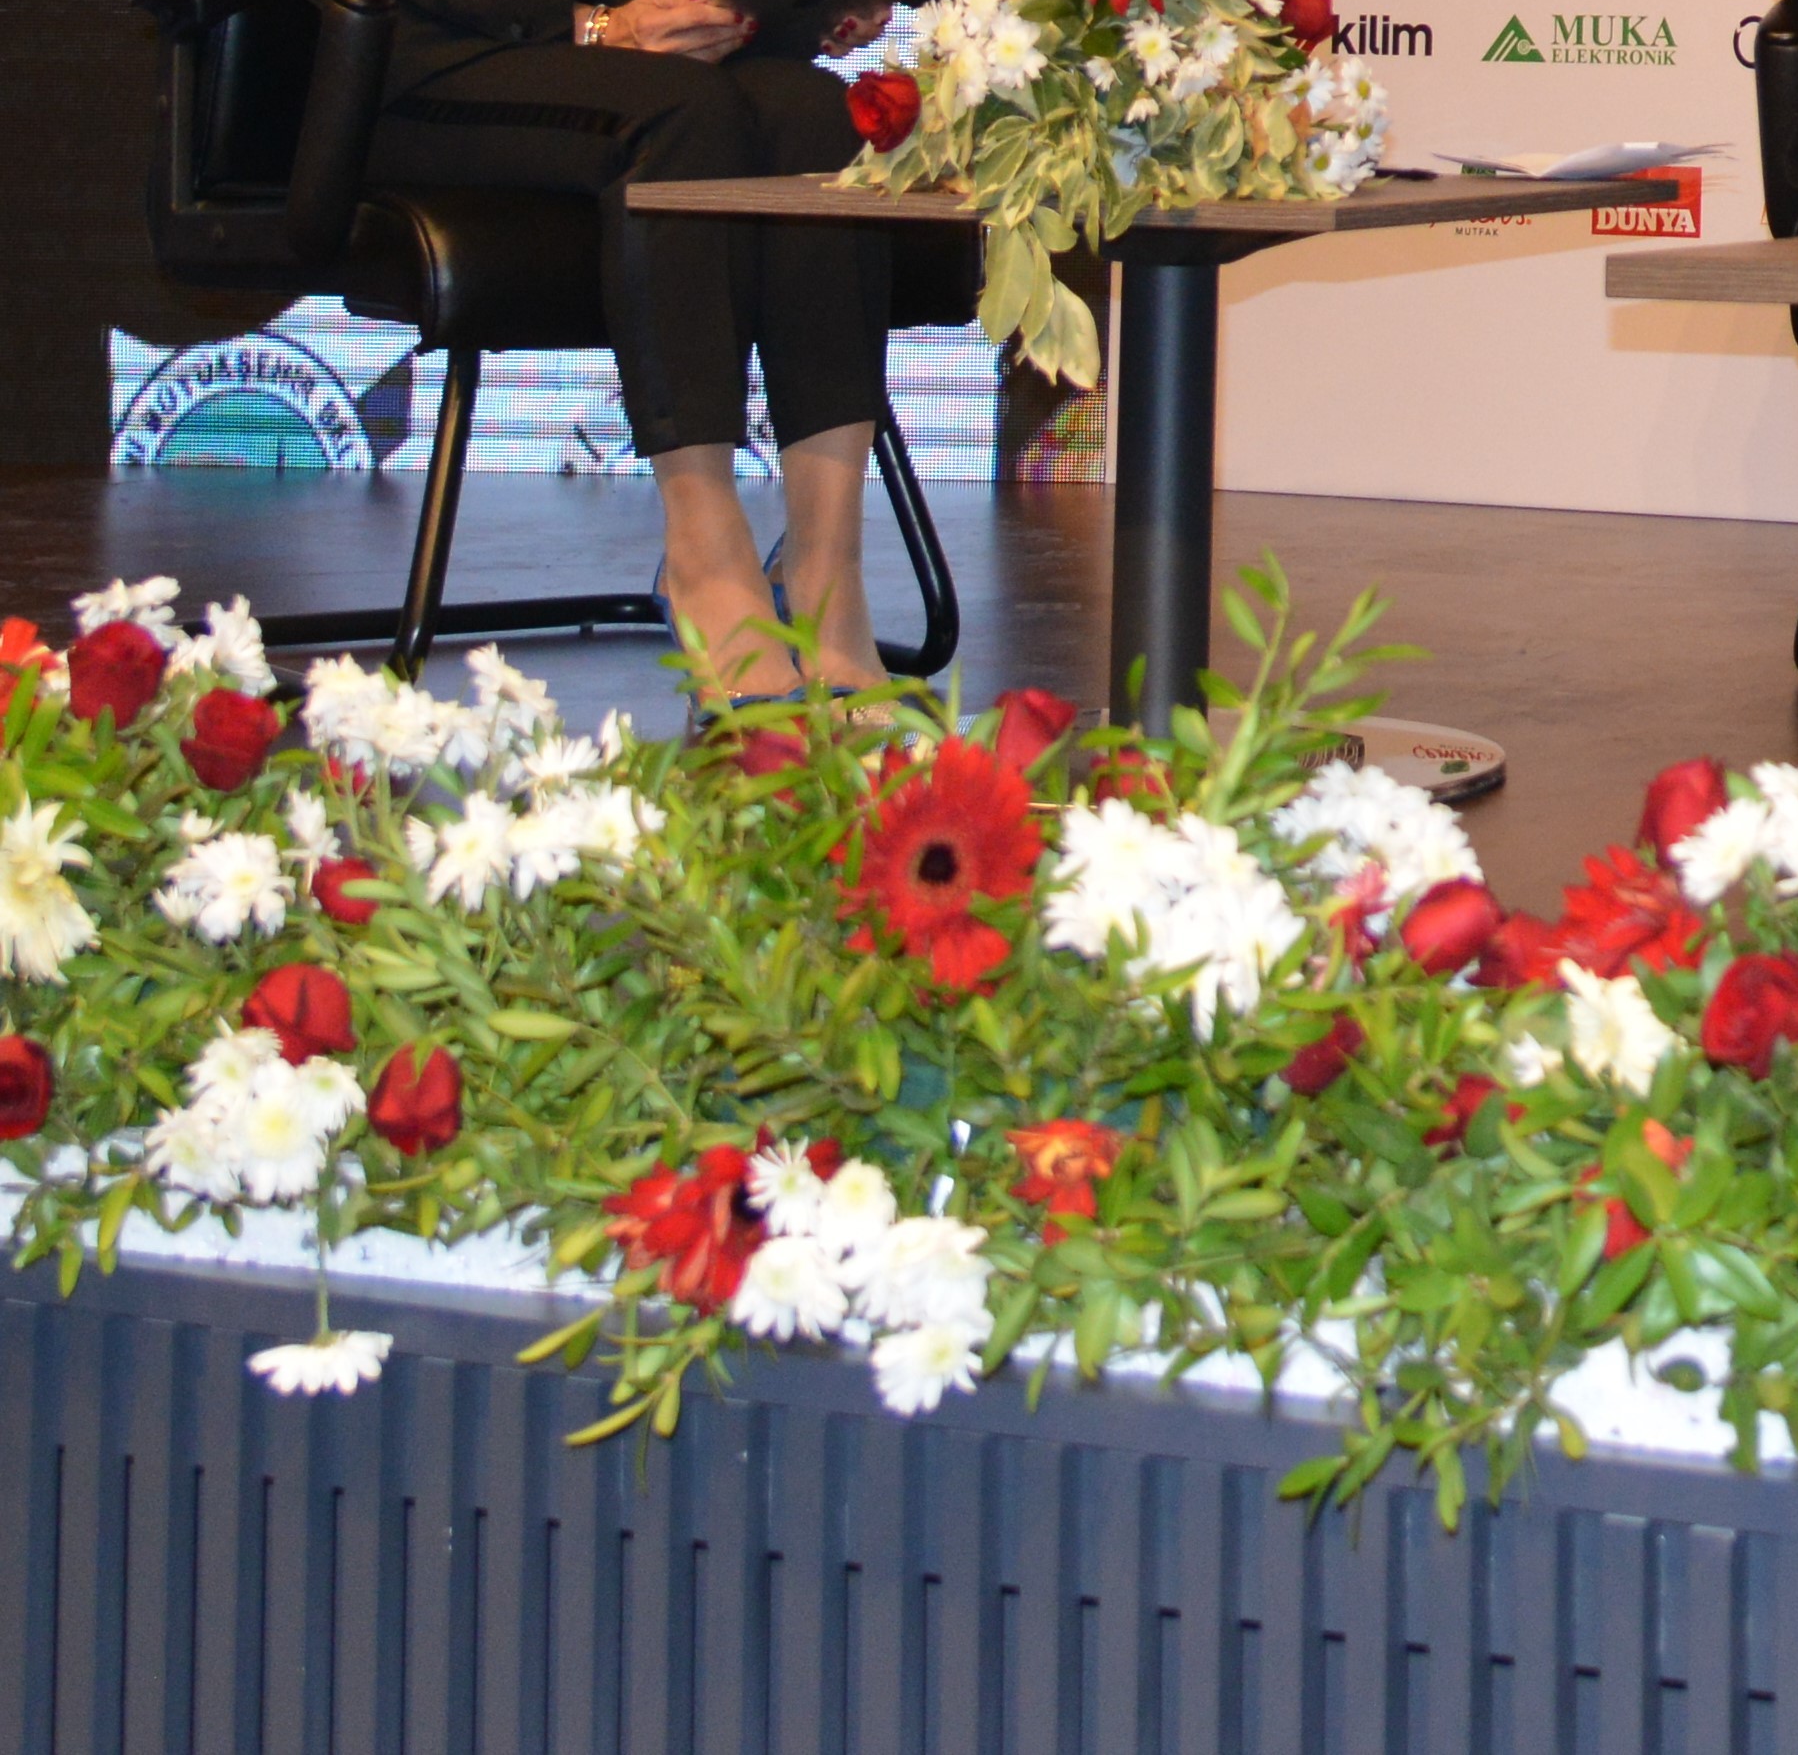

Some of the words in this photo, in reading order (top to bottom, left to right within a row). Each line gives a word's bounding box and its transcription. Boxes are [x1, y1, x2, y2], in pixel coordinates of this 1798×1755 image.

[1331, 15, 1433, 57] kilim
[1552, 14, 1677, 46] MUKA
[1455, 227, 1499, 237] MUTFAK
[1596, 205, 1696, 233] DÜNYA
